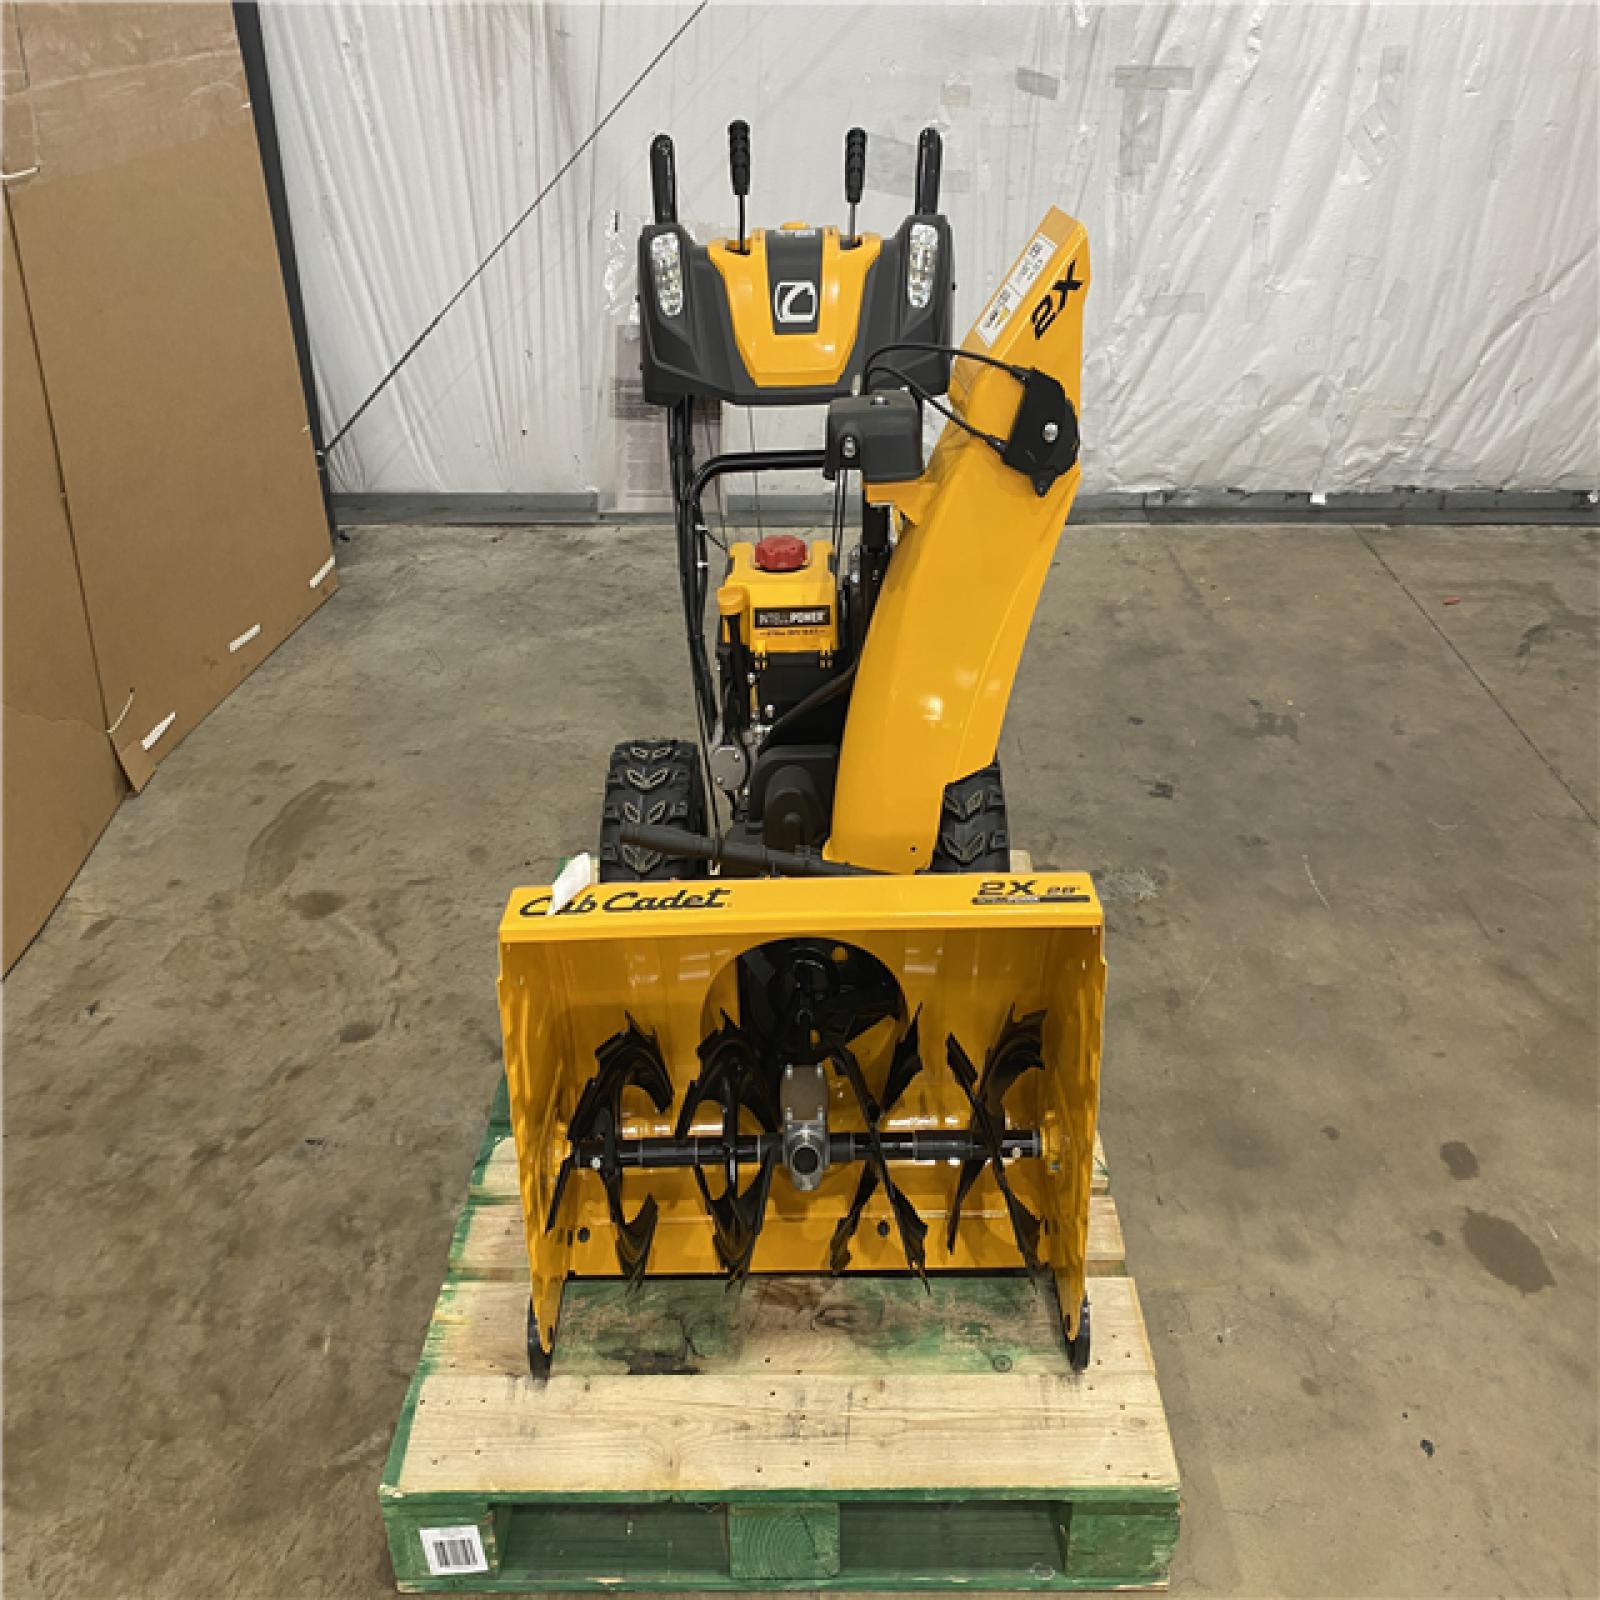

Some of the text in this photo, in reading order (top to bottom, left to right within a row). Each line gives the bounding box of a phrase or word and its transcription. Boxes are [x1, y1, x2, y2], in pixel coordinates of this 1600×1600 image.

[1030, 258, 1083, 340] 2X
[602, 887, 731, 911] Cadet
[978, 879, 1037, 896] 2X
